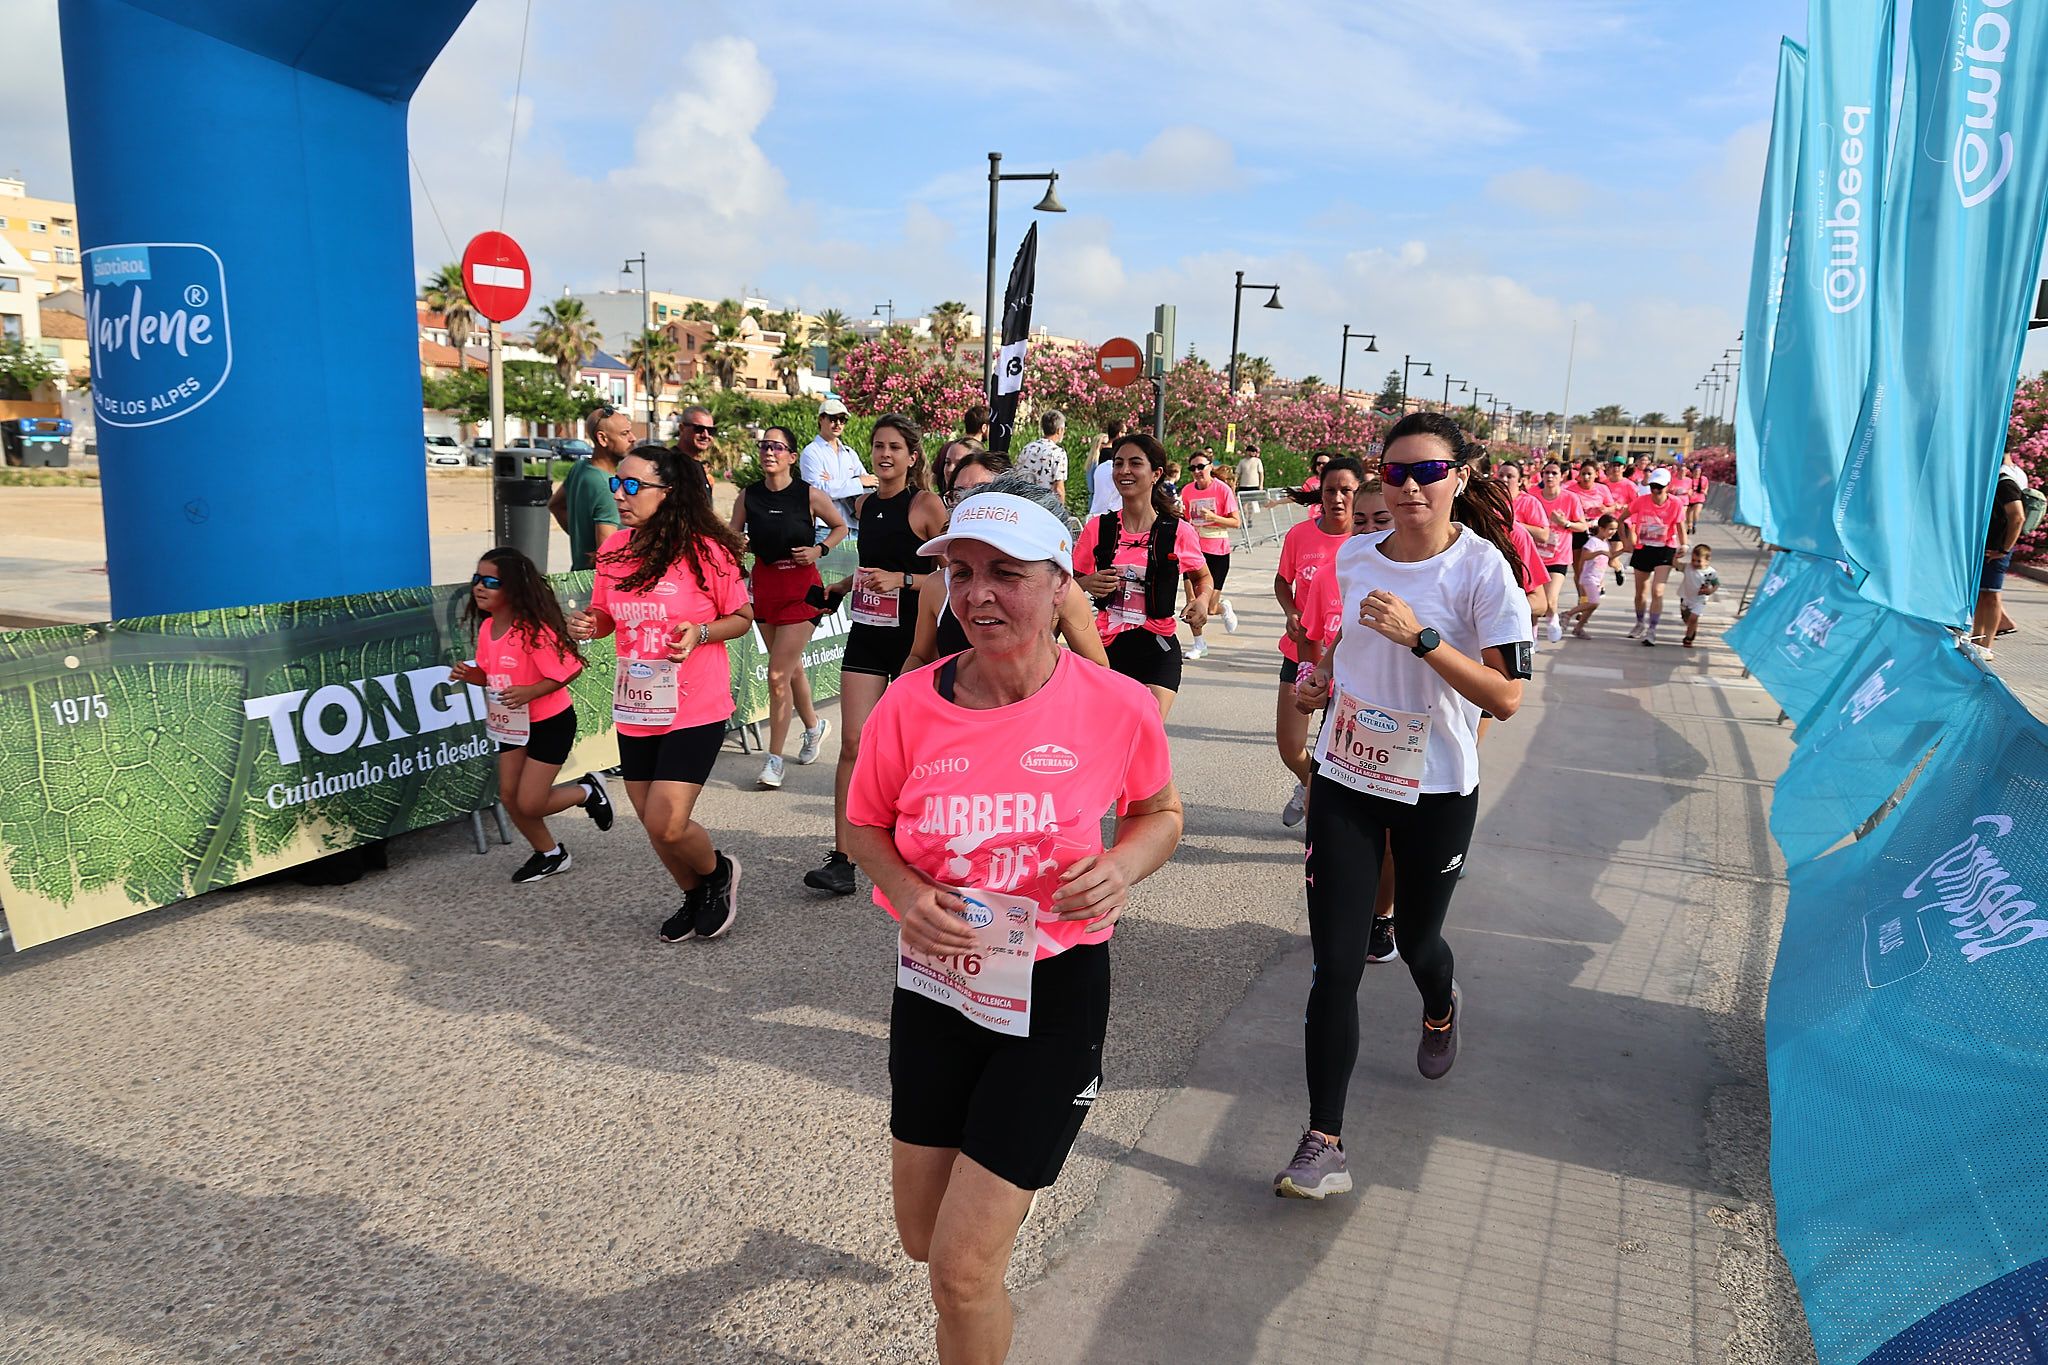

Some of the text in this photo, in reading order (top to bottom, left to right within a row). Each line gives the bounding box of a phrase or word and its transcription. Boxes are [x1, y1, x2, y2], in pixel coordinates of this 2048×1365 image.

[86, 284, 213, 379] Marlene
[105, 376, 201, 415] DE LOS ALPES
[862, 594, 881, 606] 016
[609, 602, 668, 621] CARRERA
[643, 627, 661, 653] DE
[801, 643, 845, 669] de ti desde
[628, 688, 653, 701] 016
[50, 693, 109, 726] 1975
[243, 660, 487, 765] TONGI
[490, 712, 510, 724] 016
[1358, 712, 1395, 731] ASTURIANA
[1025, 755, 1075, 767] ASTURIANA
[1352, 741, 1390, 764] 016
[266, 759, 384, 810] Cuidando
[388, 753, 414, 779] de
[416, 747, 434, 772] ti
[435, 734, 490, 766] desde
[912, 757, 970, 780] OYSHO
[1330, 766, 1357, 784] OYSHO
[1358, 760, 1378, 771] 5269
[1355, 767, 1363, 775] LA
[1384, 774, 1409, 786] VALENCIA
[1374, 784, 1407, 797] Santander
[919, 792, 1059, 836] CARRERA
[912, 975, 951, 1000] OYSHO
[976, 994, 1013, 1009] VALENCIA
